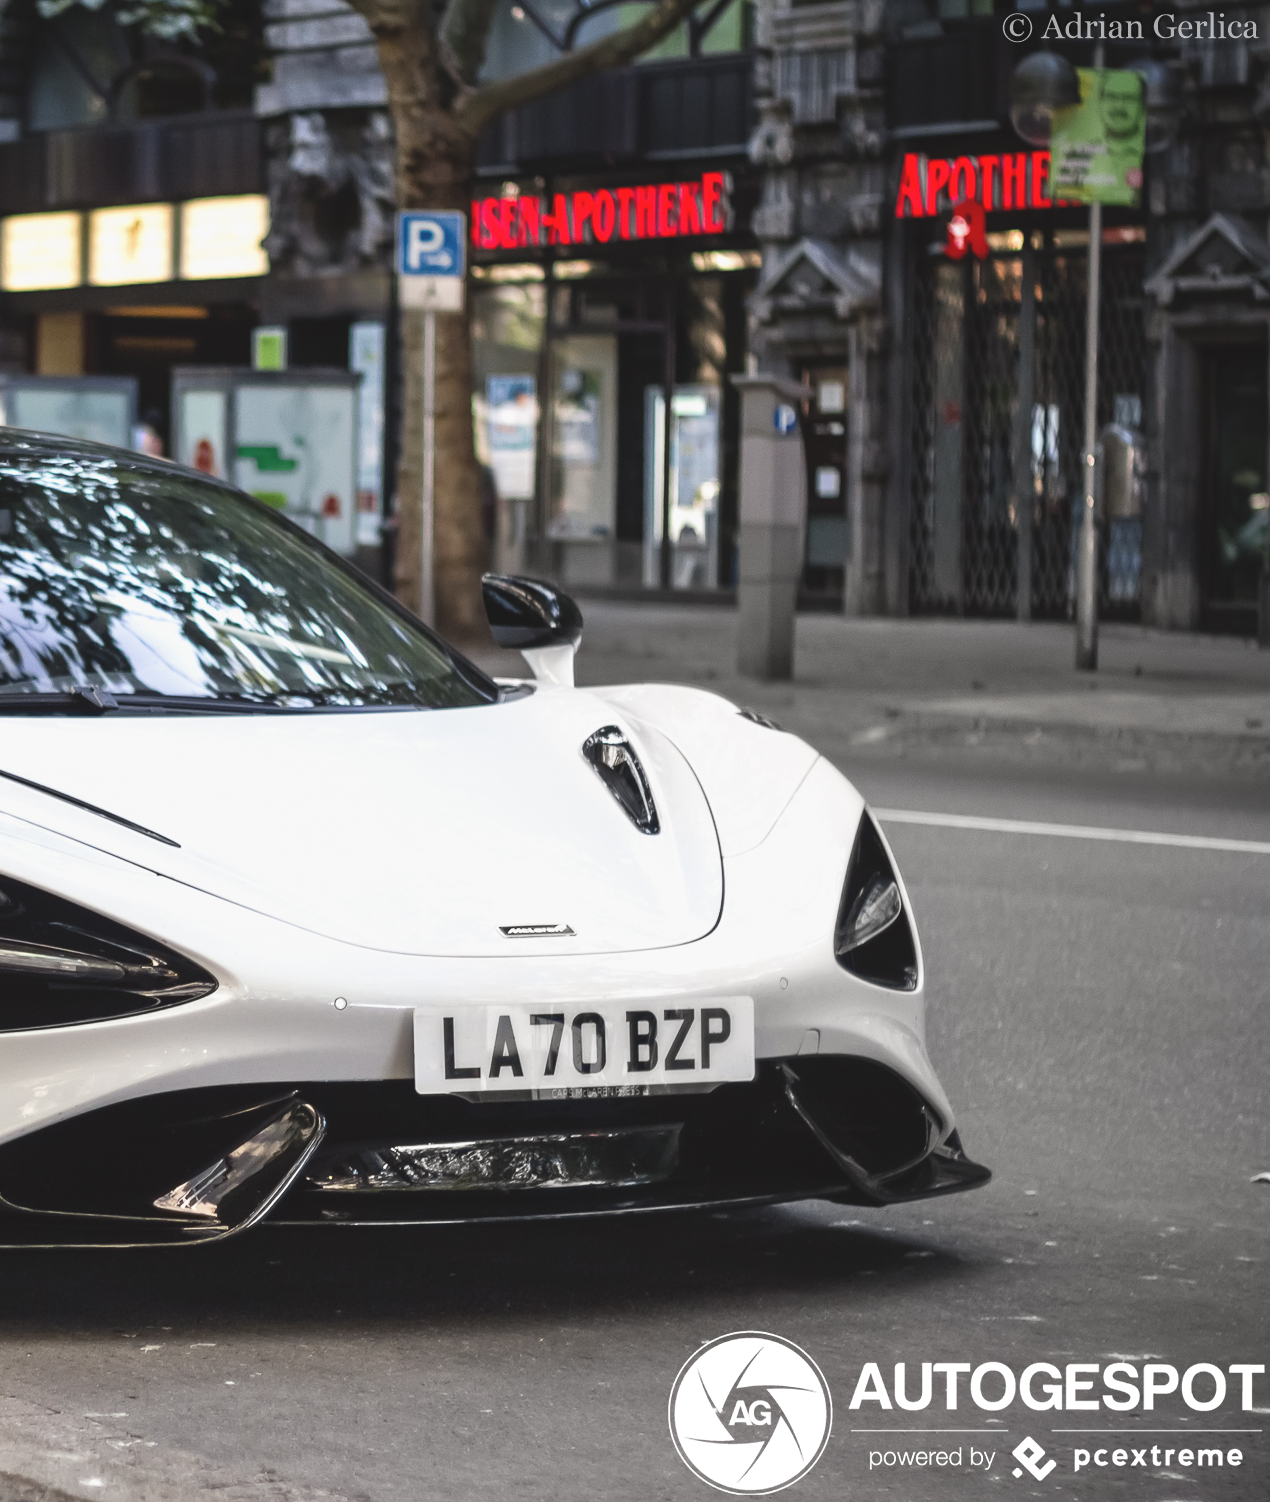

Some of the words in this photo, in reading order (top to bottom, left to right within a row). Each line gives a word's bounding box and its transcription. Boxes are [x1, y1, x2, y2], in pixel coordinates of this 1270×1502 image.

[895, 152, 1083, 218] APOTHE
[409, 220, 444, 270] P
[443, 1012, 606, 1080] LA70
[626, 1008, 731, 1072] BZP
